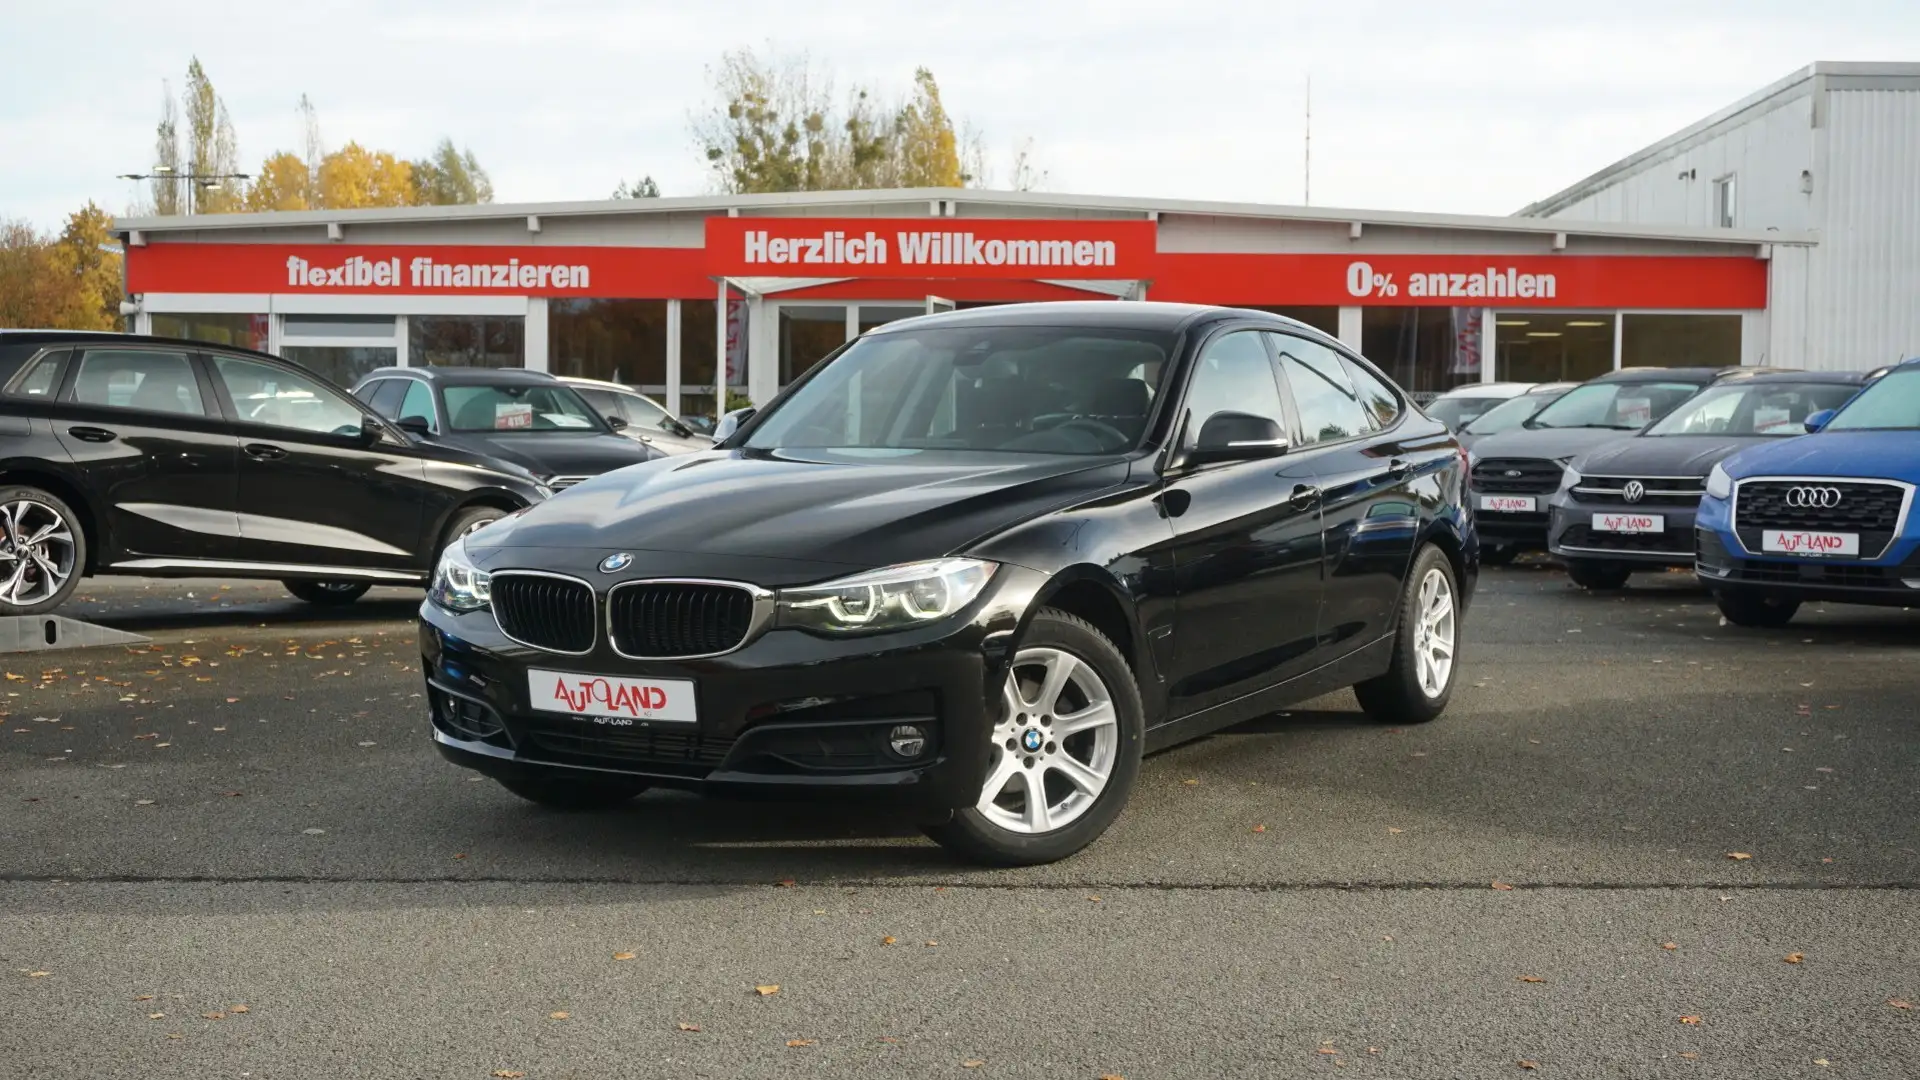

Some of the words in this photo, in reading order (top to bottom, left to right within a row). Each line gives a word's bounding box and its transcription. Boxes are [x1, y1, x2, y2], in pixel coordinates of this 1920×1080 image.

[745, 231, 887, 264] Herzlich
[897, 232, 1115, 266] Willkommen
[287, 255, 400, 287] flexibel
[410, 257, 589, 288] finanzieren
[1346, 261, 1398, 297] 0%
[1408, 267, 1556, 297] anzahlen
[1777, 532, 1843, 552] AUTOLAND
[554, 676, 667, 716] AUTOLAND
